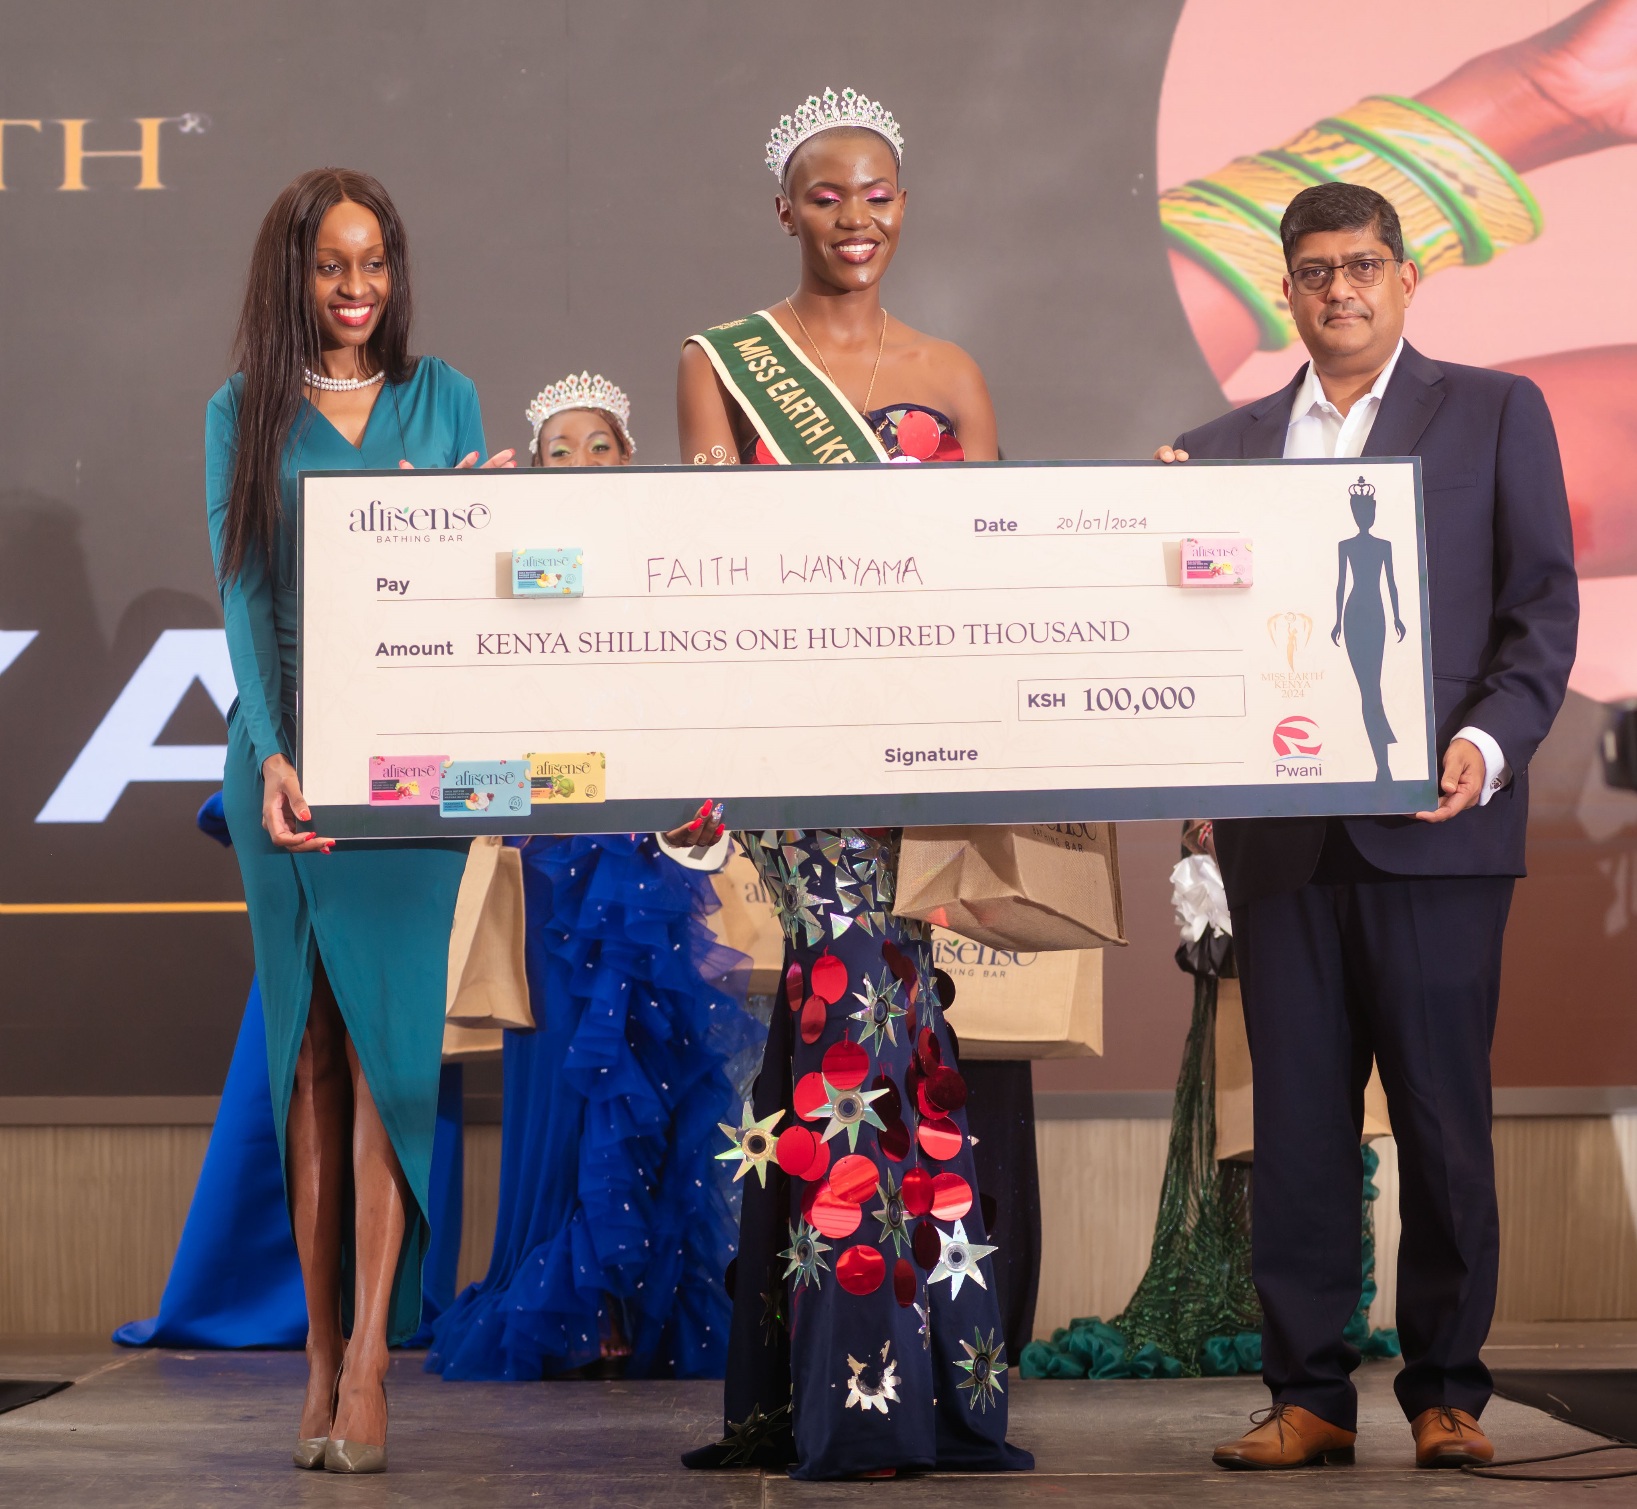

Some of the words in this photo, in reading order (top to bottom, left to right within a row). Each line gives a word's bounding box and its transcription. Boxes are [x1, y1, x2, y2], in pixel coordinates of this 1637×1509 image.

[733, 336, 786, 382] MISS
[766, 377, 836, 445] EARTH
[812, 435, 858, 464] KE
[974, 518, 1018, 532] Date
[1056, 509, 1148, 532] 20/07/2024
[376, 535, 431, 543] BATHING
[439, 534, 463, 542] BAR
[647, 556, 749, 593] FAITH
[779, 554, 924, 587] WANYAMA
[376, 577, 410, 595] Pay
[375, 641, 454, 657] Amount
[476, 632, 571, 655] KENYA
[578, 630, 728, 653] SHILLINGS
[736, 628, 798, 650] ONE
[807, 624, 956, 649] HUNDRED
[963, 620, 1130, 645] THOUSAND
[1261, 672, 1286, 682] MISS
[1288, 671, 1324, 681] EARTH
[1274, 680, 1312, 690] KENYA
[1027, 693, 1066, 708] KSH
[1083, 686, 1196, 715] 100,000
[1281, 689, 1305, 699] 2024
[0, 629, 238, 823] A
[884, 747, 978, 766] Signature
[1275, 764, 1322, 778] Pwani
[1064, 841, 1084, 853] BAR
[932, 938, 1038, 967] isense
[940, 967, 975, 977] HING
[983, 970, 1006, 978] BAR
